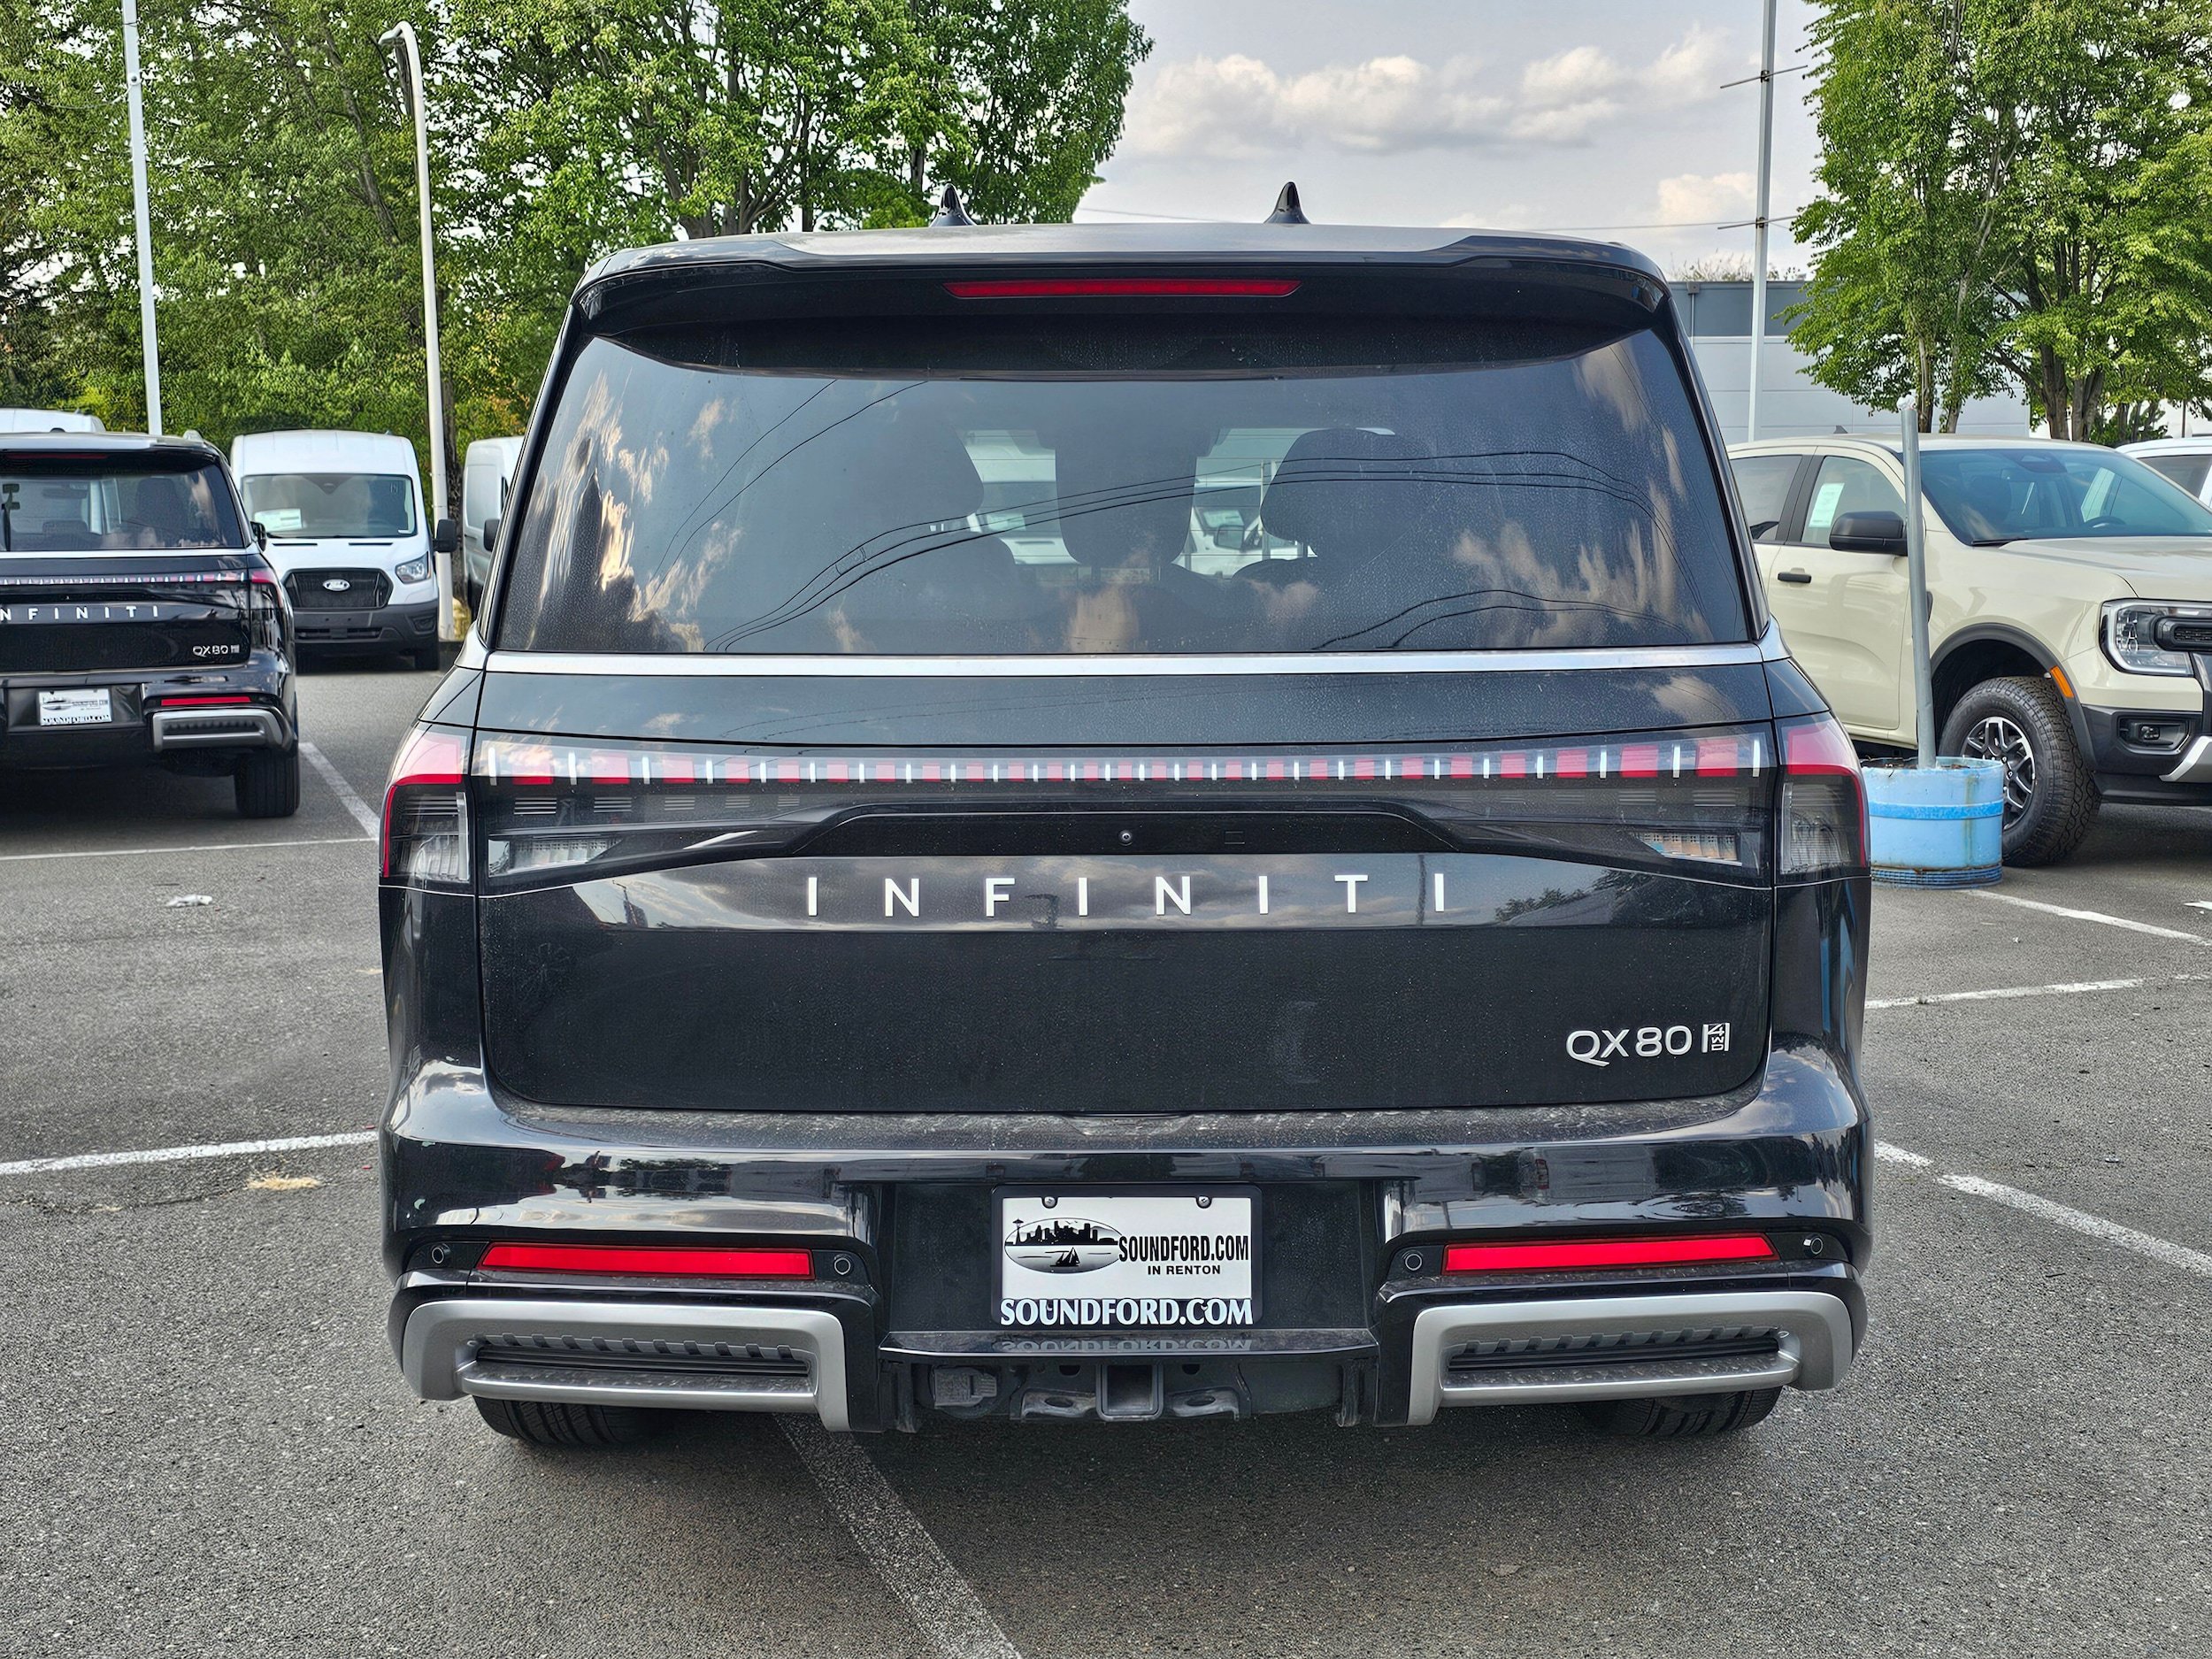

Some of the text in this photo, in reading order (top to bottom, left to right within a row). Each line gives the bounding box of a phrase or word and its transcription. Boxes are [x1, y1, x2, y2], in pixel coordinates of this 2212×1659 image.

[807, 872, 1446, 918] INFINITI
[1566, 1025, 1693, 1067] QX80
[1118, 1235, 1249, 1262] SOUNDFORD.COM
[1148, 1264, 1221, 1275] IN RENTON
[1000, 1298, 1254, 1325] SOUNDFORD.COM
